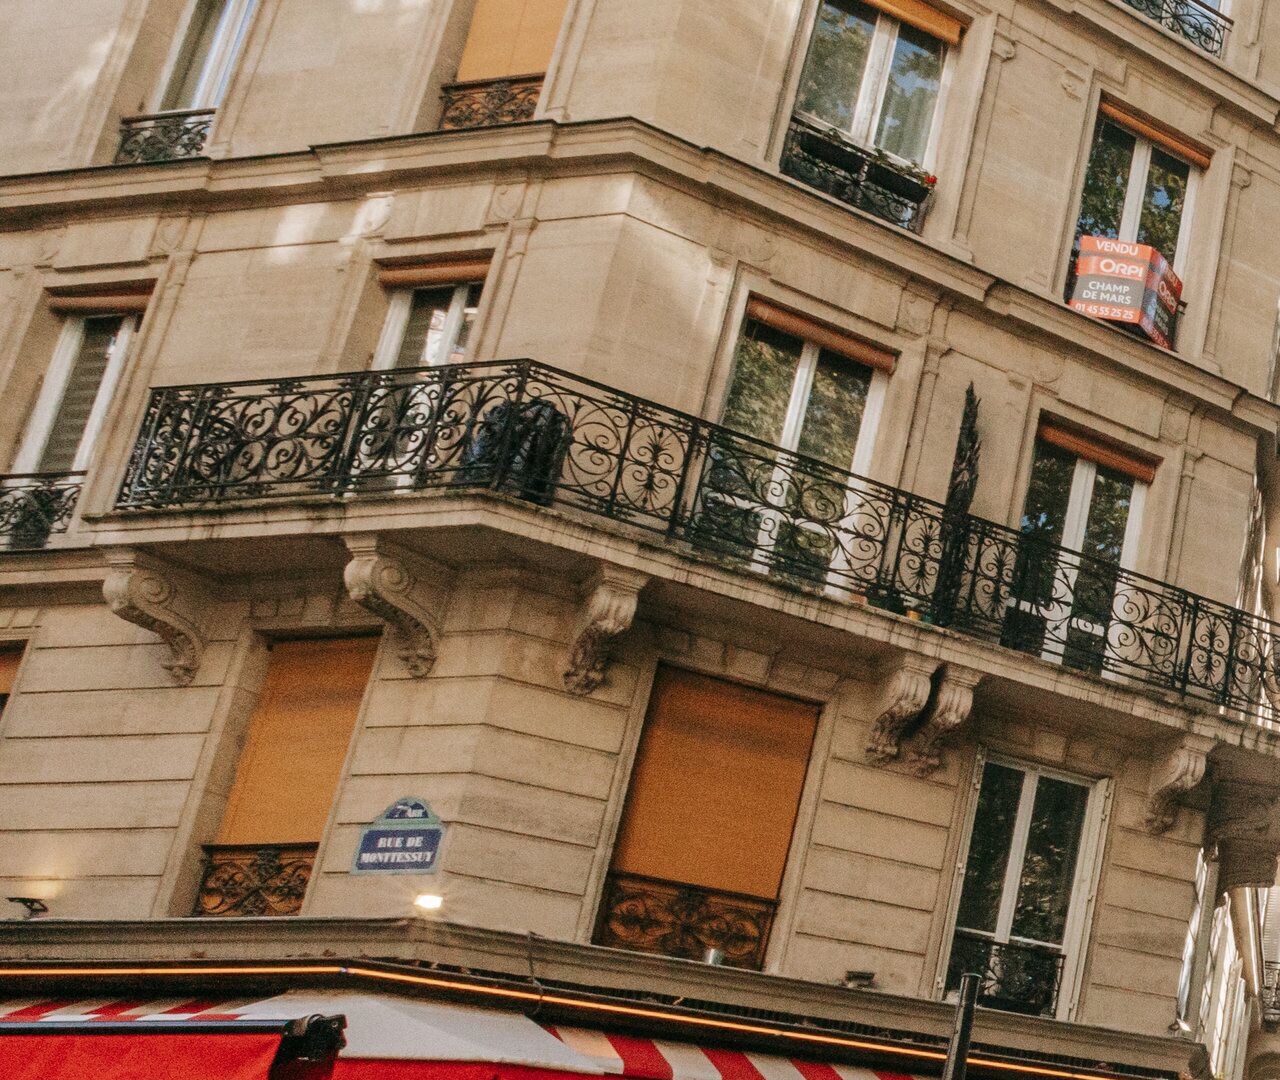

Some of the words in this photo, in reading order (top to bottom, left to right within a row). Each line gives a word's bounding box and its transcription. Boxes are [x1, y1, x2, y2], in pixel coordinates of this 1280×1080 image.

[1096, 240, 1138, 256] VENDU
[1100, 258, 1144, 277] ORPI
[1088, 281, 1130, 294] CHAMP
[1082, 290, 1097, 300] DE
[1100, 293, 1132, 305] MARS
[1075, 303, 1085, 312] 01
[1087, 305, 1098, 314] 45
[1099, 306, 1110, 316] 55
[1111, 308, 1122, 317] 25
[1122, 310, 1134, 319] 25
[377, 837, 404, 848] RUE
[406, 836, 424, 847] DE
